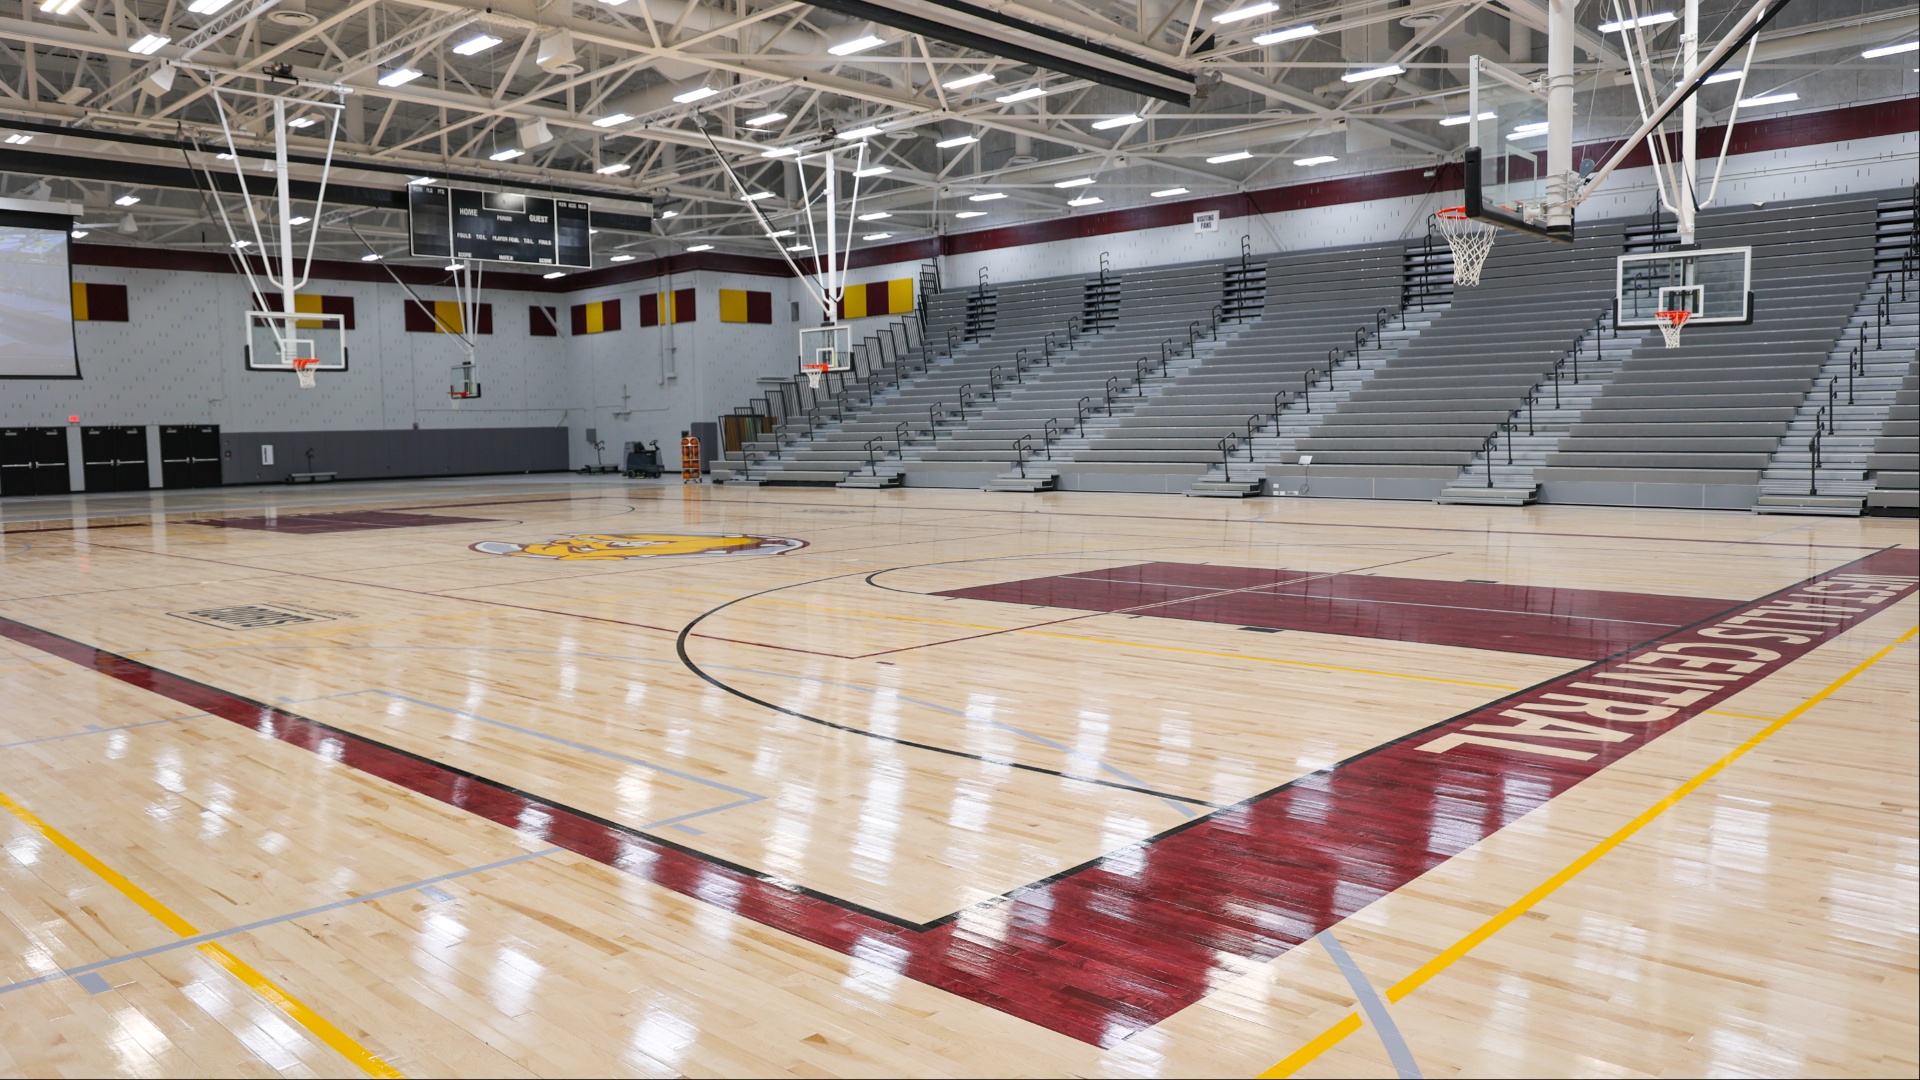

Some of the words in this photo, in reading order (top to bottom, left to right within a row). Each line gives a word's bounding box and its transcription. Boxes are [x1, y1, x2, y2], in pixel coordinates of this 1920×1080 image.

[459, 208, 478, 217] HOME
[529, 214, 549, 223] GUEST
[1197, 214, 1214, 223] VISITING
[1802, 573, 1920, 605] WEST
[1698, 600, 1867, 645] HILLS
[1413, 642, 1782, 762] CENTRAL
